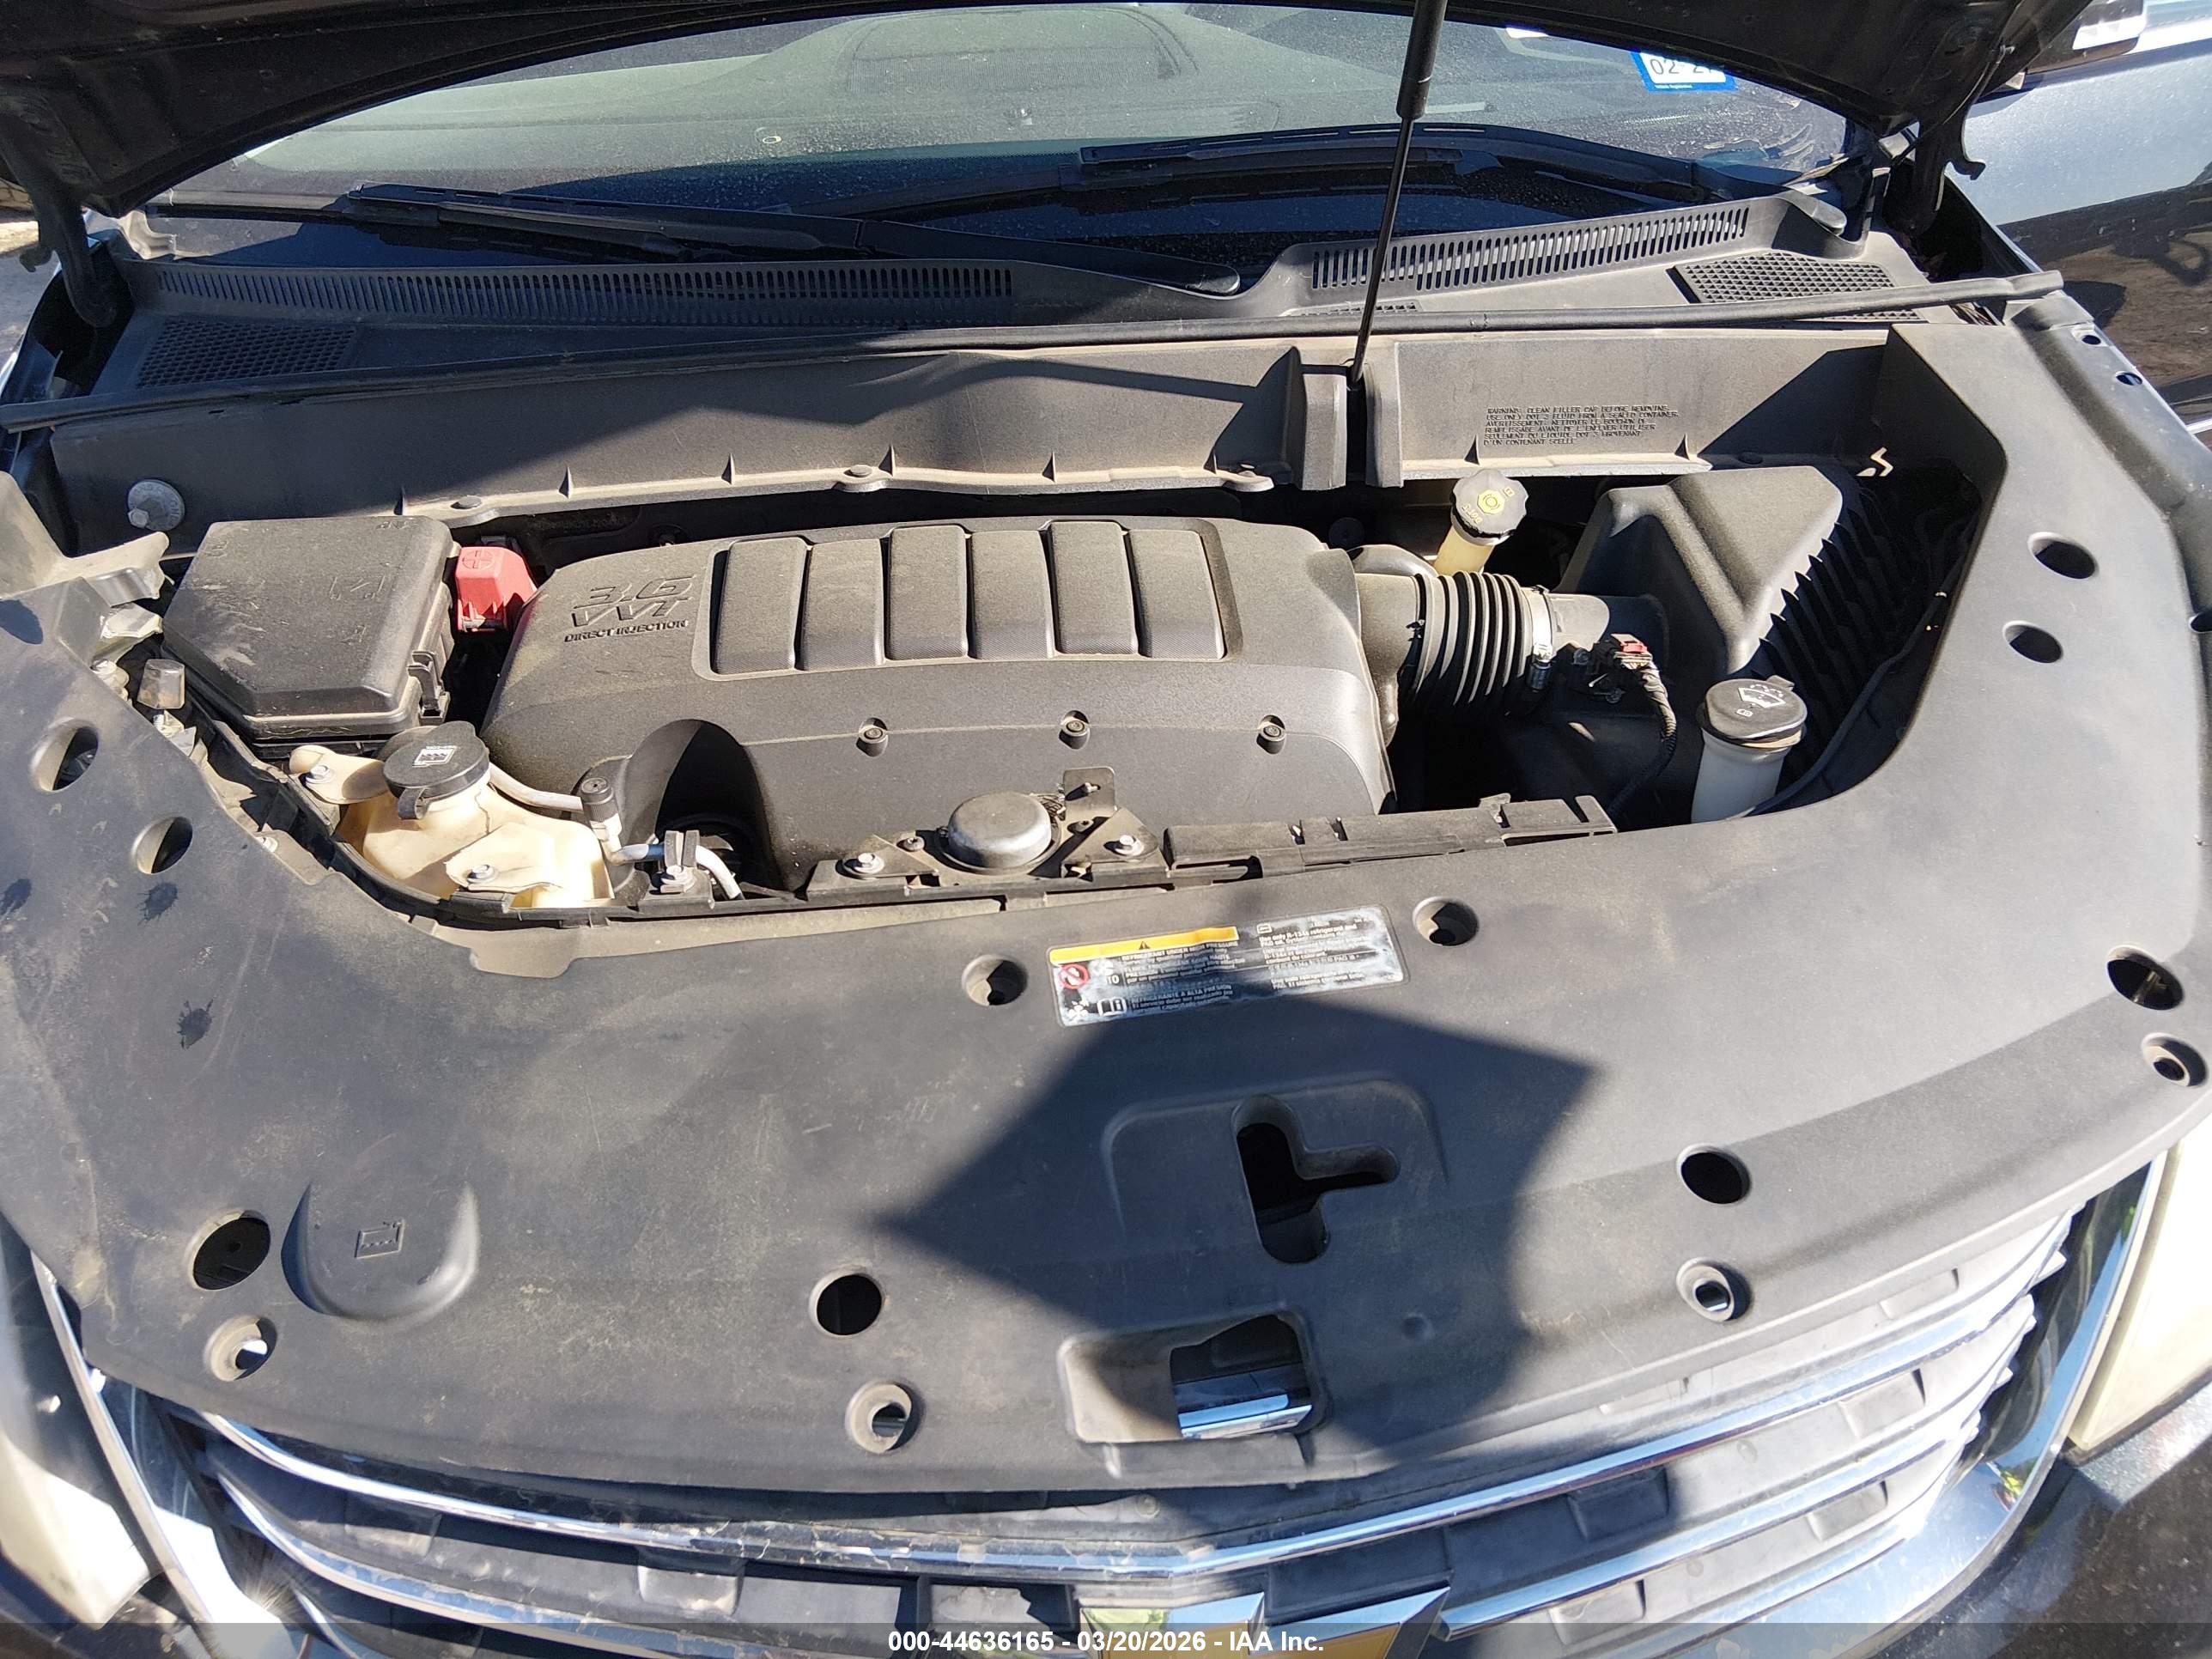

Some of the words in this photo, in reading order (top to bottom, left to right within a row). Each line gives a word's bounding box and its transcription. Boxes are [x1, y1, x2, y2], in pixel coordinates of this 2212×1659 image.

[1552, 418, 1588, 427] NETTOYER
[570, 598, 695, 628] VVT
[563, 626, 614, 643] DIRECT
[613, 618, 690, 636] INJECTION
[1272, 933, 1286, 942] only
[1310, 926, 1344, 937] refrigerant
